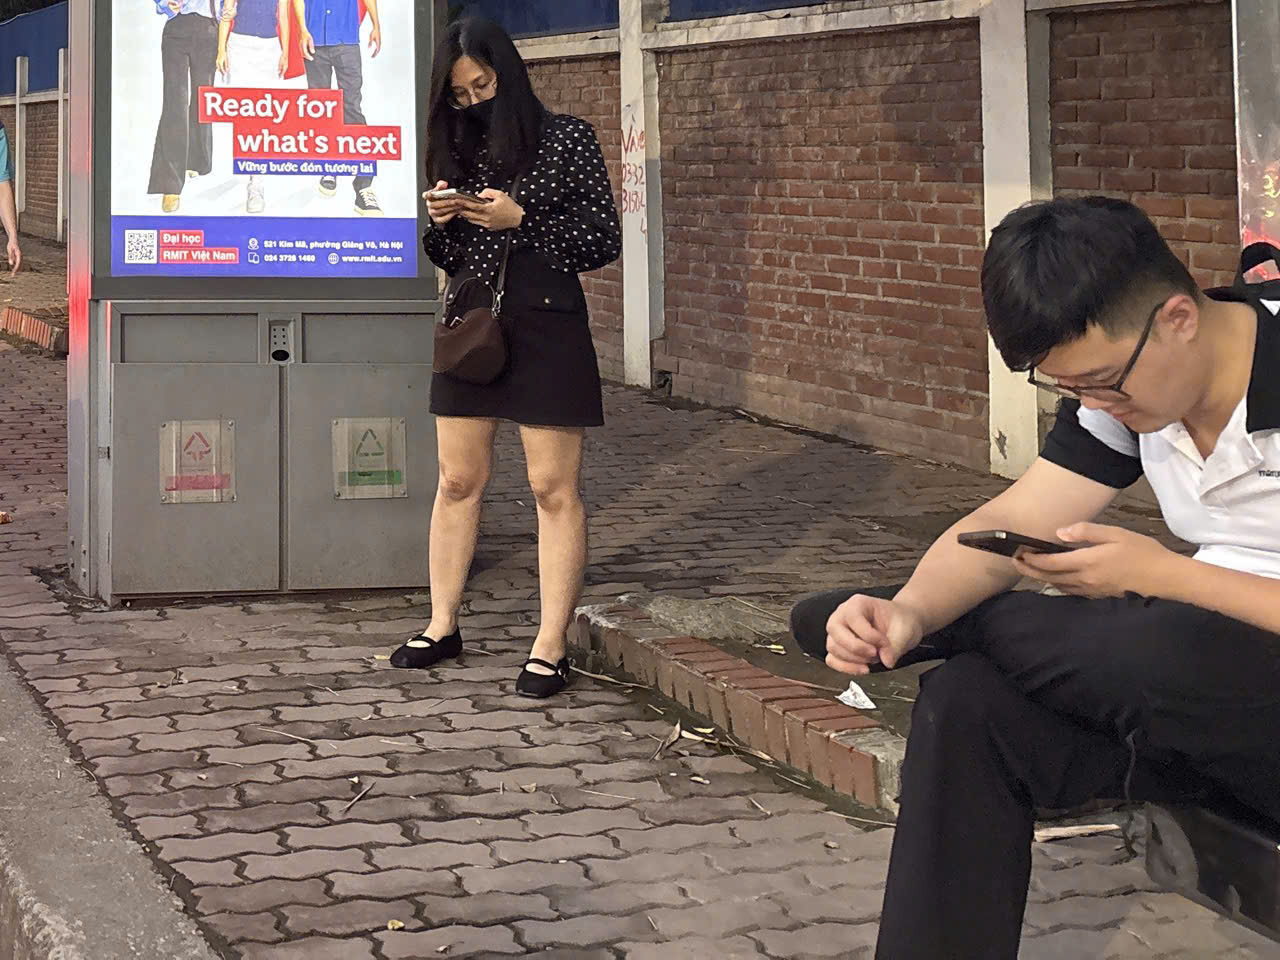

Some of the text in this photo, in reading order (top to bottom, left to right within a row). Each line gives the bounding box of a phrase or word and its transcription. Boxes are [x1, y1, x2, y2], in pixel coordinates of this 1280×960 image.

[204, 92, 338, 124] Ready for
[237, 129, 397, 155] what's next
[237, 161, 374, 175] Vững bước đón tương lai
[163, 233, 200, 245] Đại học
[163, 251, 235, 261] RMIT Việt Nam
[342, 255, 402, 263] www.rmit.edu.vn
